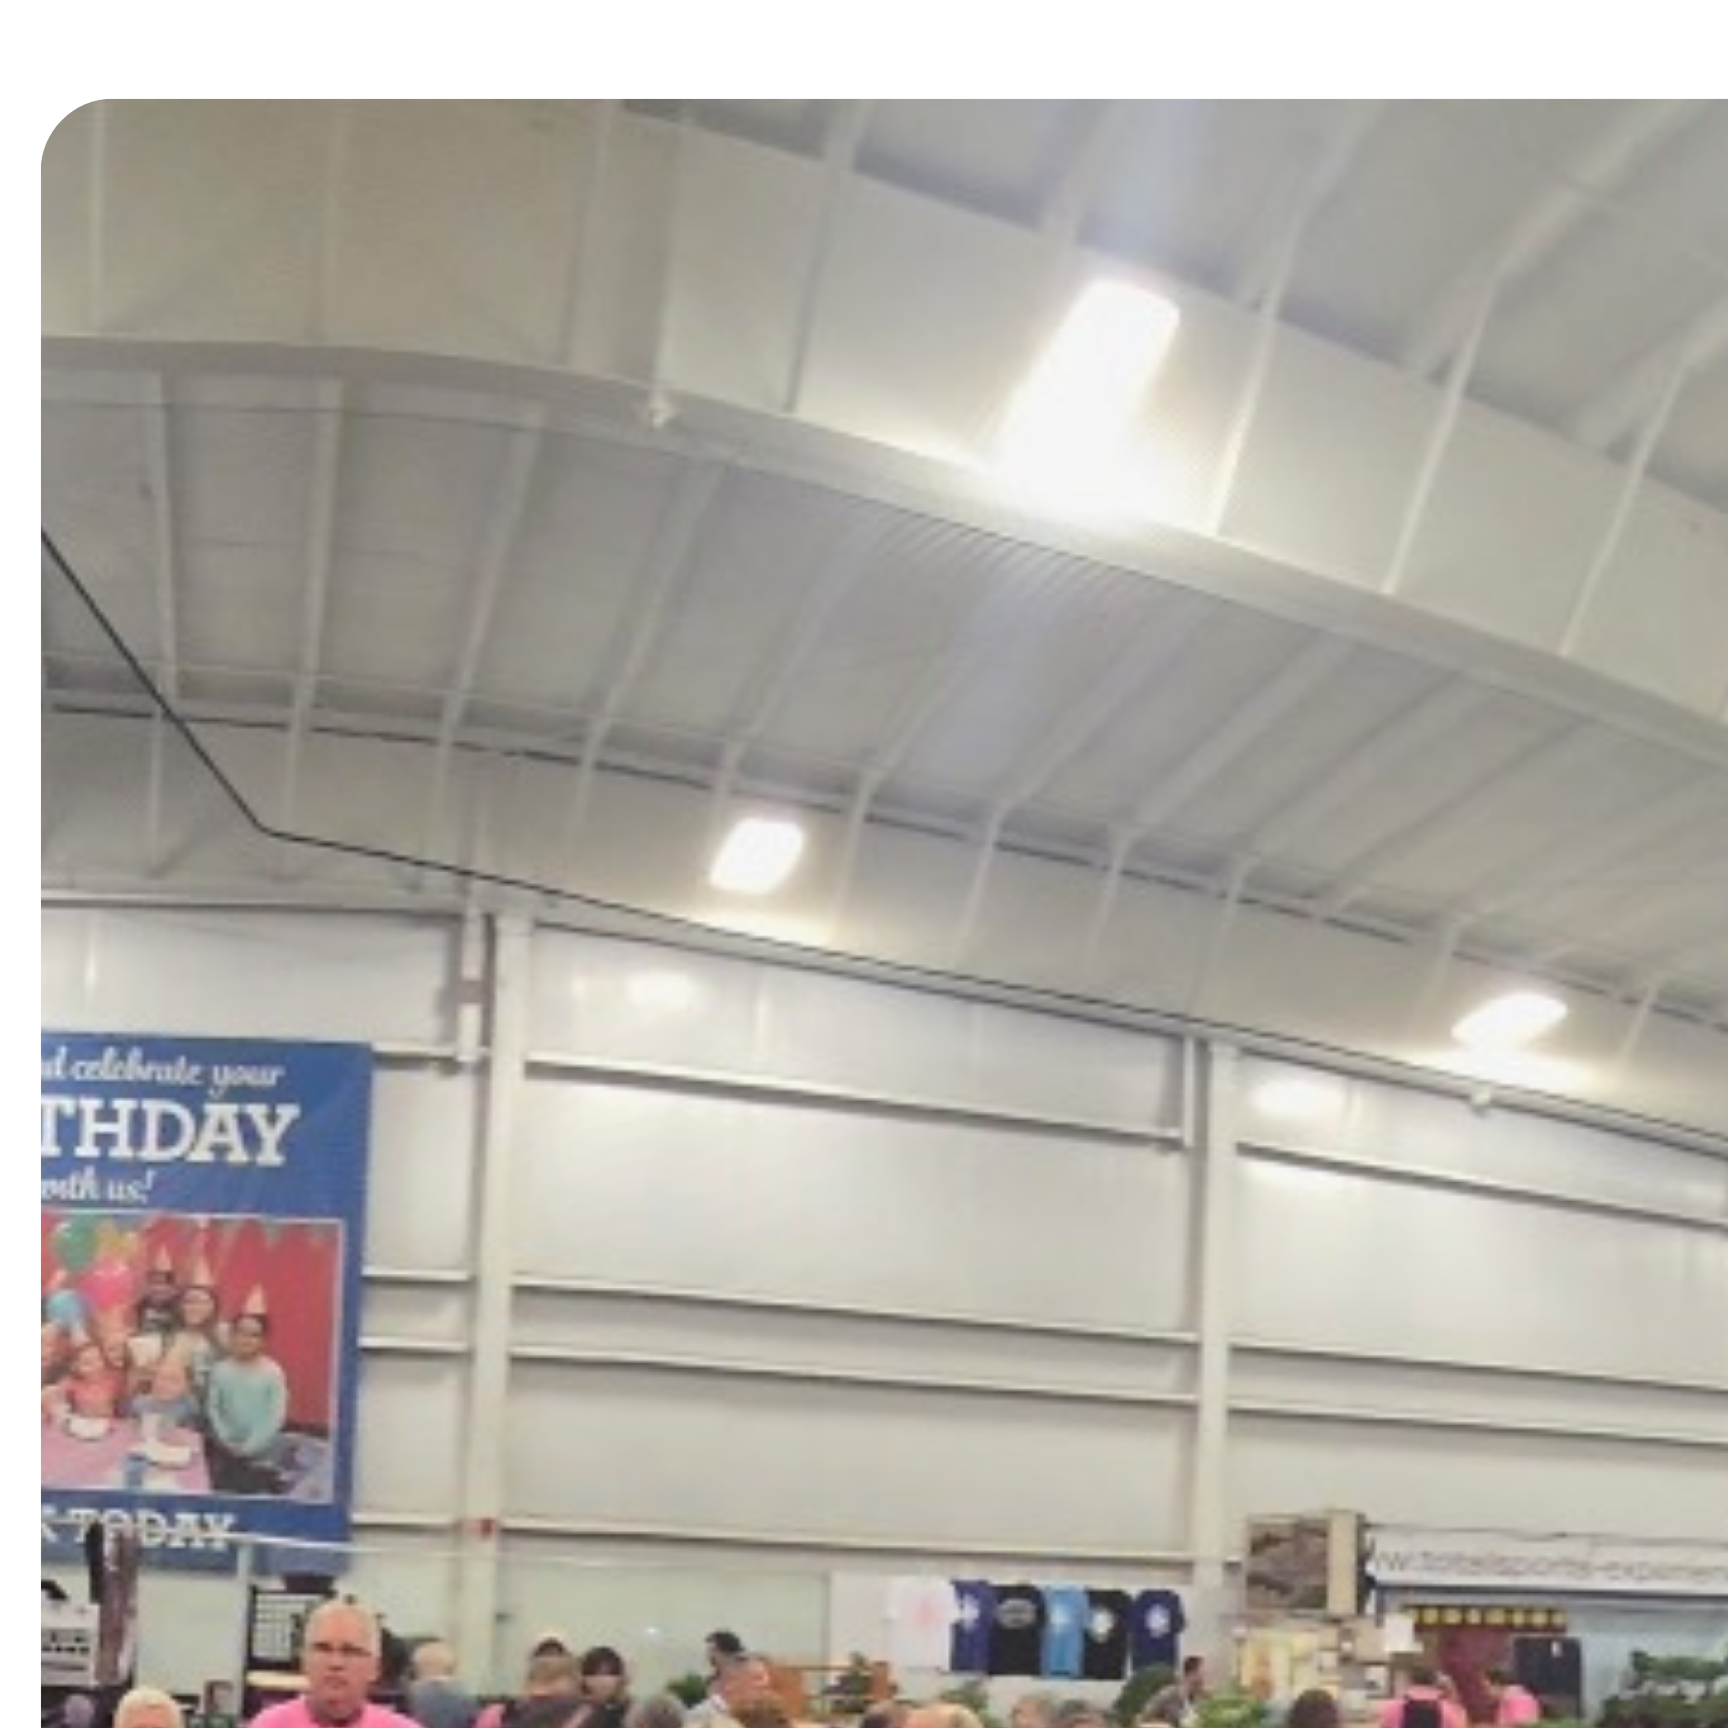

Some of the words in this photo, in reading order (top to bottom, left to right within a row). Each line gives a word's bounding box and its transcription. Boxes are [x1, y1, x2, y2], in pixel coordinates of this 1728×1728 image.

[73, 1046, 202, 1086] celebrate
[208, 1063, 286, 1098] your
[40, 1093, 300, 1167] THDAY
